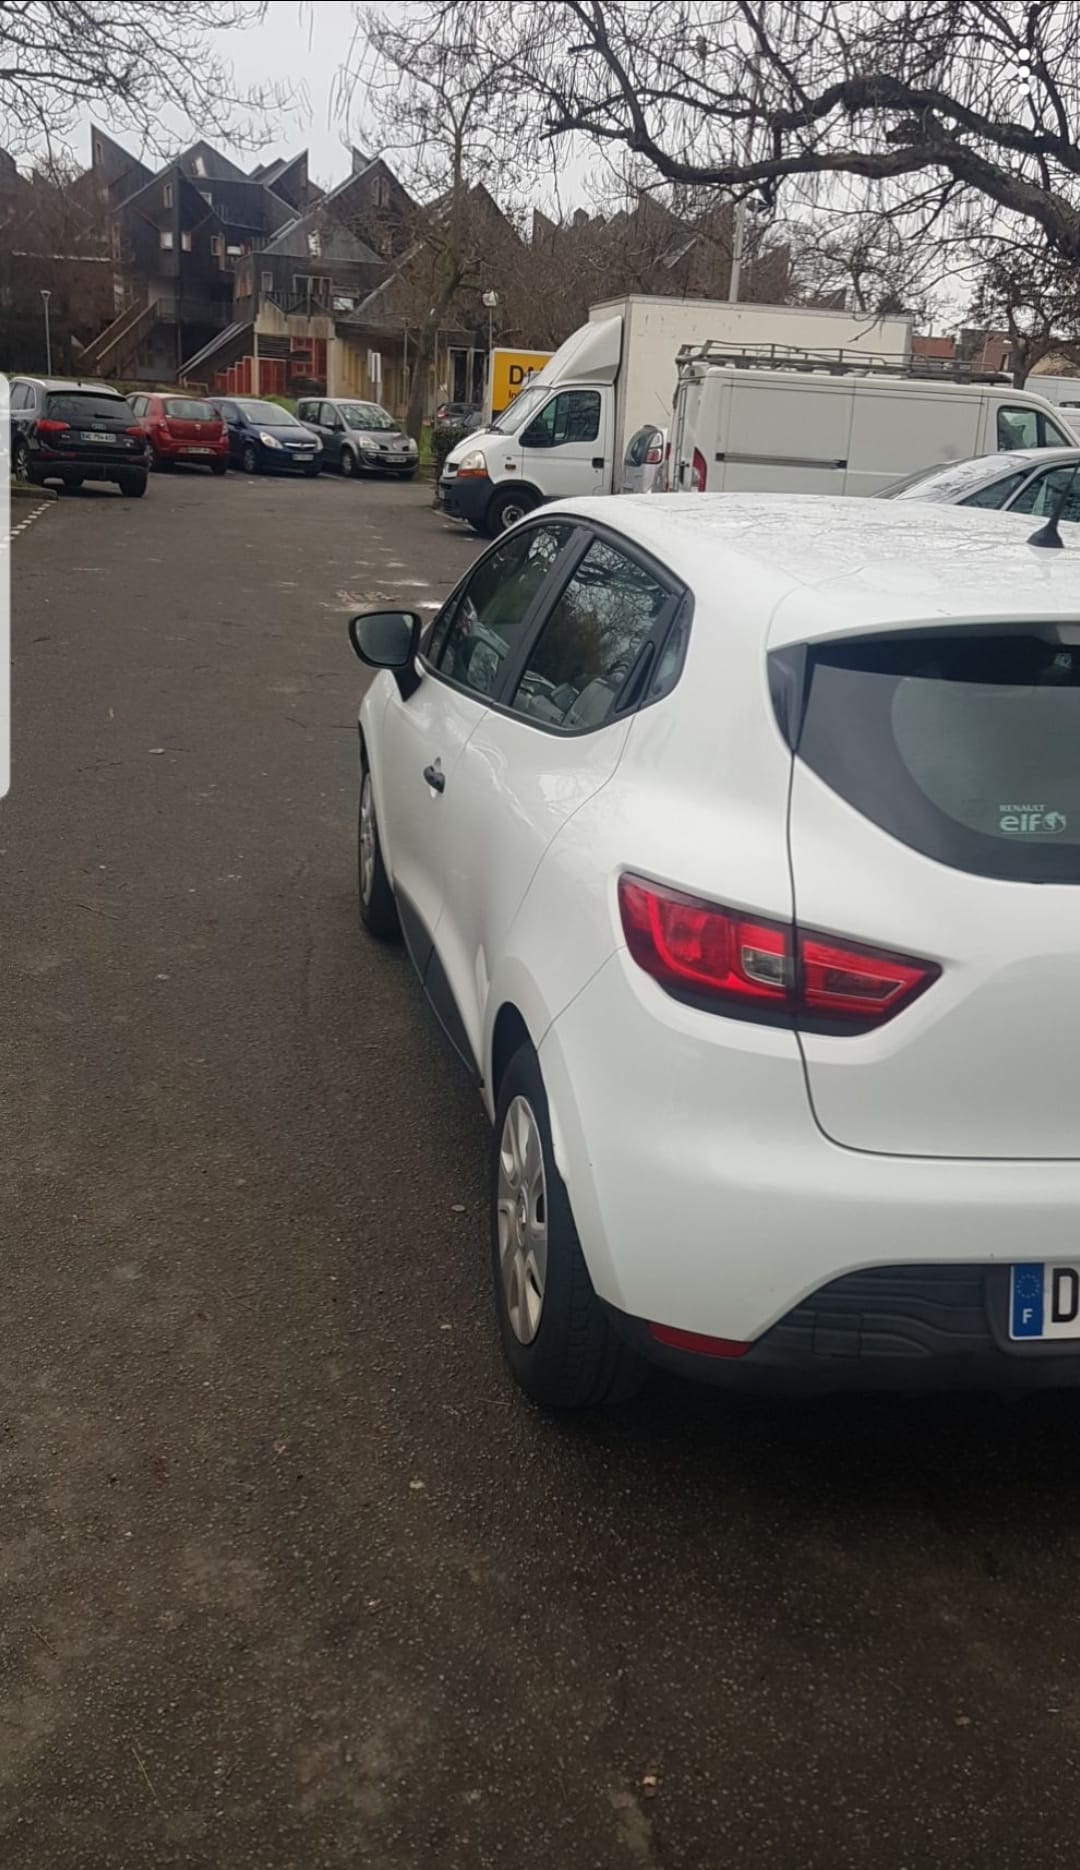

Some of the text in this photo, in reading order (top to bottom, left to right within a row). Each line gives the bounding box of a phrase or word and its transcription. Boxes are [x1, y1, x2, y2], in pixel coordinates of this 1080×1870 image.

[1000, 804, 1045, 812] RENAULT
[1000, 813, 1042, 832] elf
[1022, 1308, 1033, 1324] F
